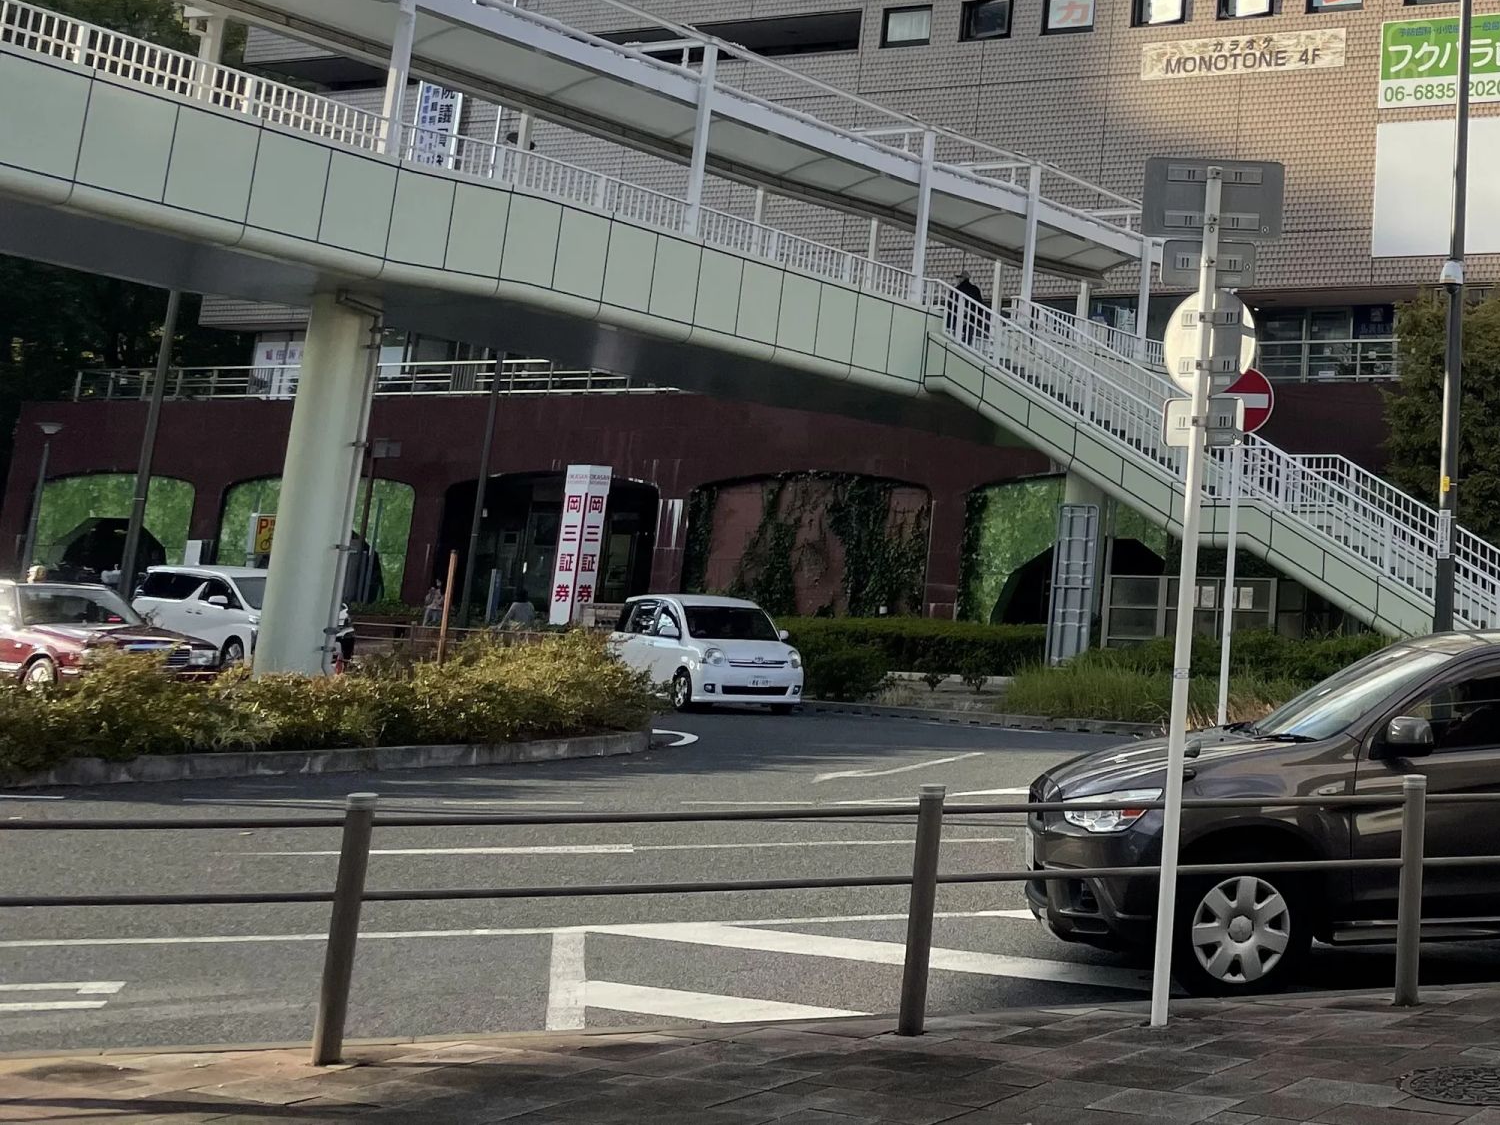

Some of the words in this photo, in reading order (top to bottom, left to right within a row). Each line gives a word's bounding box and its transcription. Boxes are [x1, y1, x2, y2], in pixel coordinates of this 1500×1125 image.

[1165, 50, 1288, 74] MONOTONE
[1299, 48, 1322, 65] 4F
[1213, 35, 1274, 53] カラオケ
[554, 495, 582, 603] 岡三証券
[577, 495, 604, 603] 岡三証券
